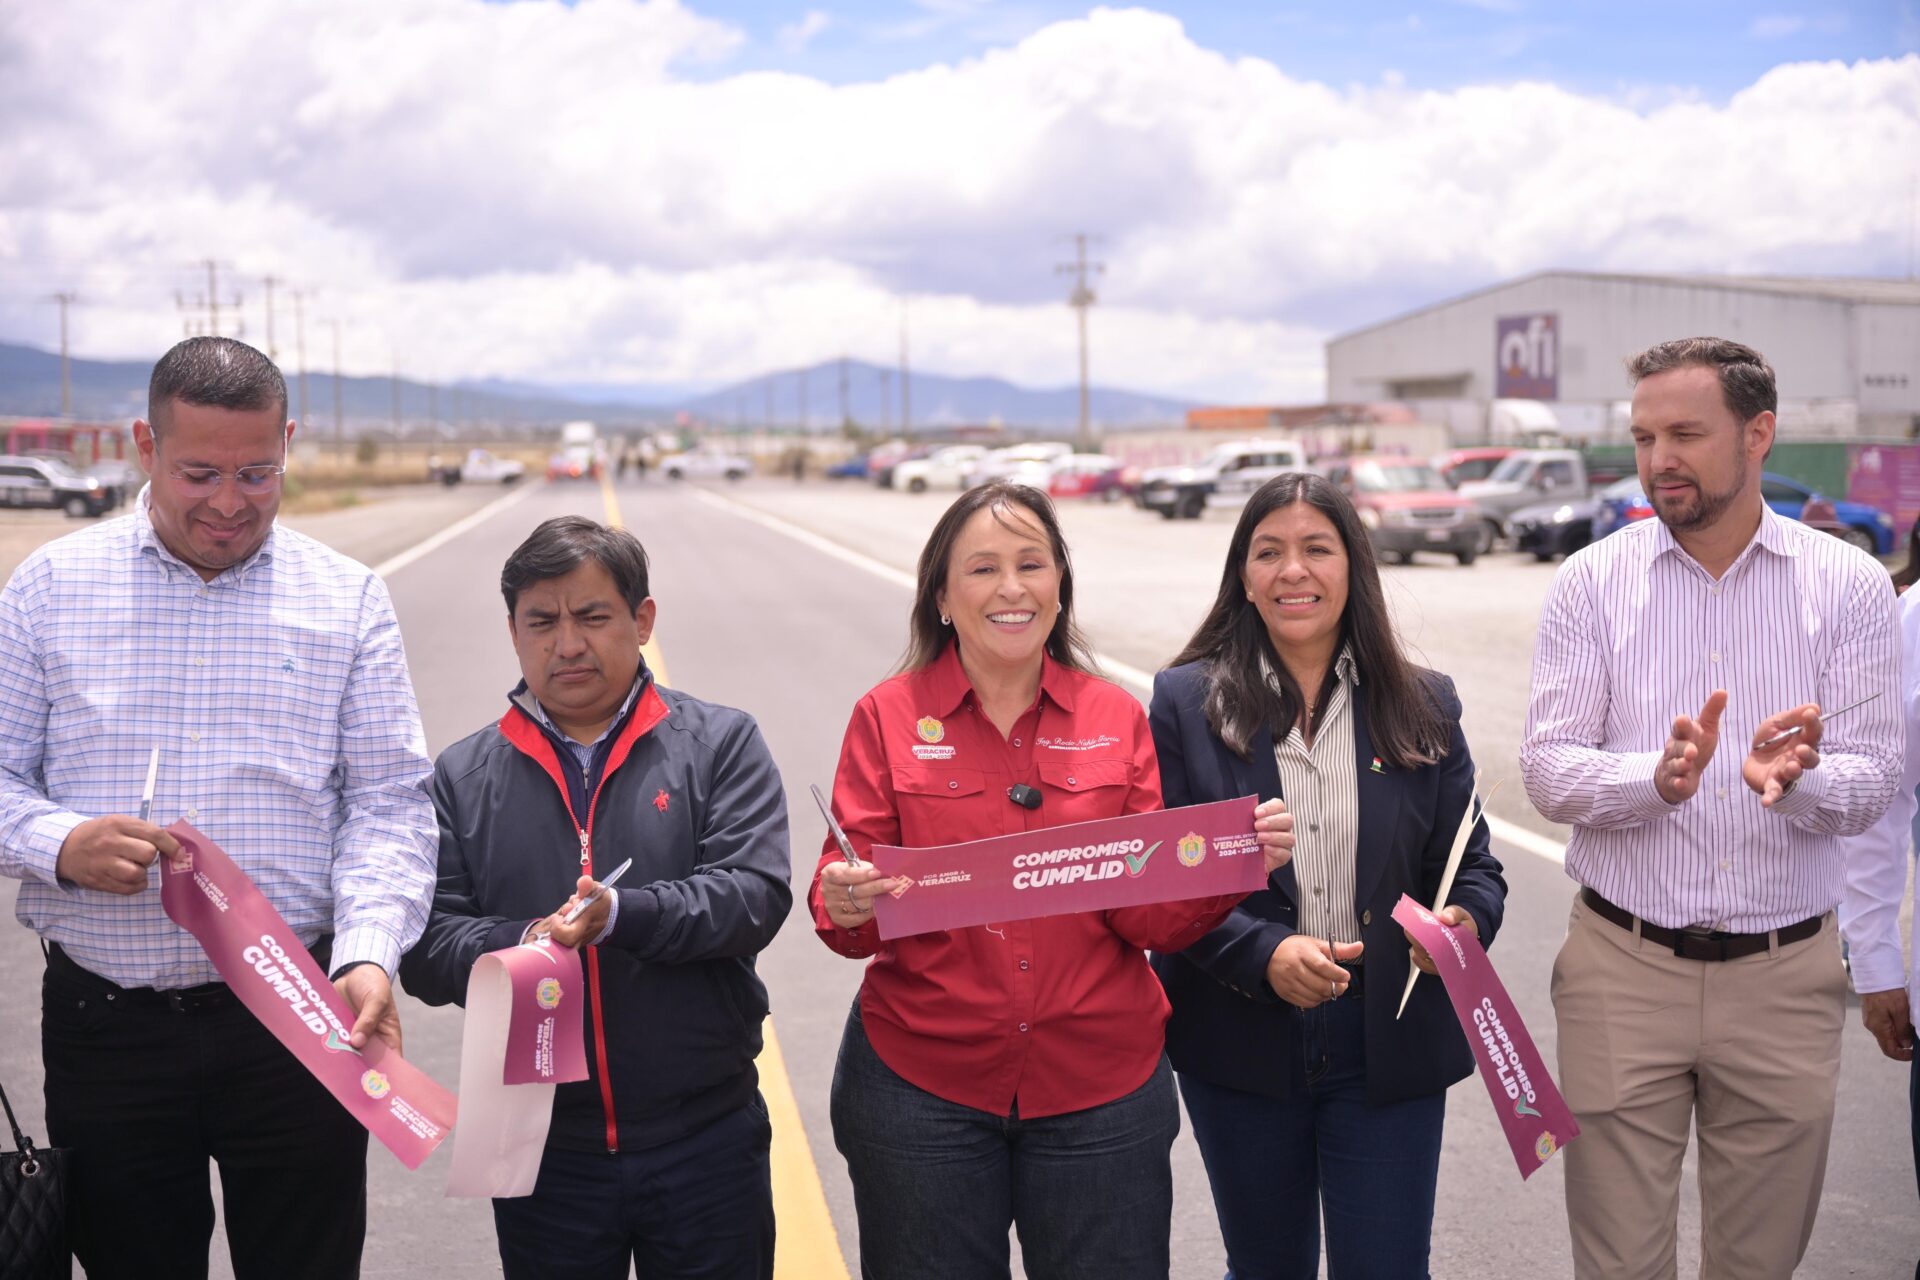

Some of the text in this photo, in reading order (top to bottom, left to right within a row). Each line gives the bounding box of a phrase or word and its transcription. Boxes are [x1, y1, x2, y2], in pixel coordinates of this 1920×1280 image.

[1500, 315, 1552, 378] ofi
[1012, 838, 1144, 868] COMPROMISO
[1218, 849, 1237, 857] 2024
[1241, 846, 1260, 854] 2030
[193, 871, 230, 912] VERACRUZ
[208, 882, 224, 898] AMOR
[917, 874, 971, 887] VERACRUZ
[1440, 926, 1467, 970] VERACRUZ
[260, 934, 351, 1041] COMPROMISO
[541, 1016, 551, 1077] VERACRUZ
[1481, 996, 1536, 1104] COMPROMISO
[389, 1107, 407, 1123] 2024
[408, 1123, 426, 1139] 2030
[390, 1097, 438, 1139] VERACRUZ
